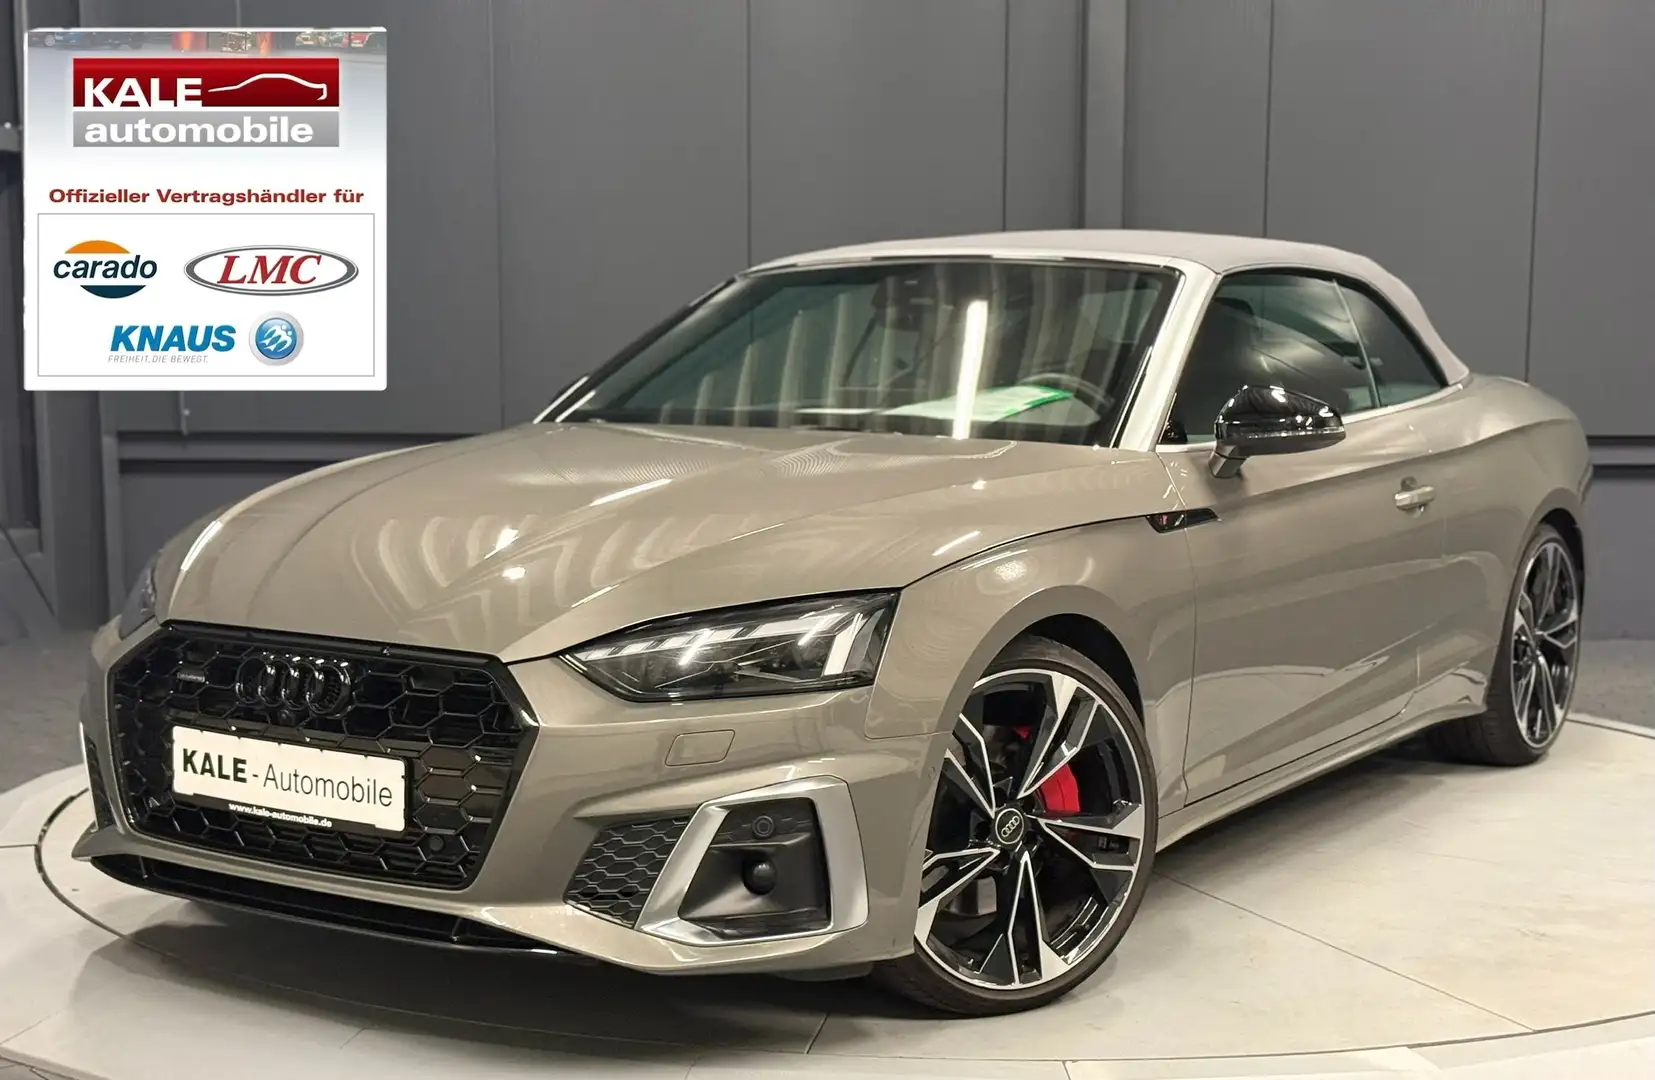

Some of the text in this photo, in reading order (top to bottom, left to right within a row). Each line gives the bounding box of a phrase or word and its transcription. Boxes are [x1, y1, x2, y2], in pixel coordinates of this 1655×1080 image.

[182, 748, 248, 784] KALE
[263, 763, 393, 807] Automobile
[228, 803, 333, 828] www.kale-automobile.de
